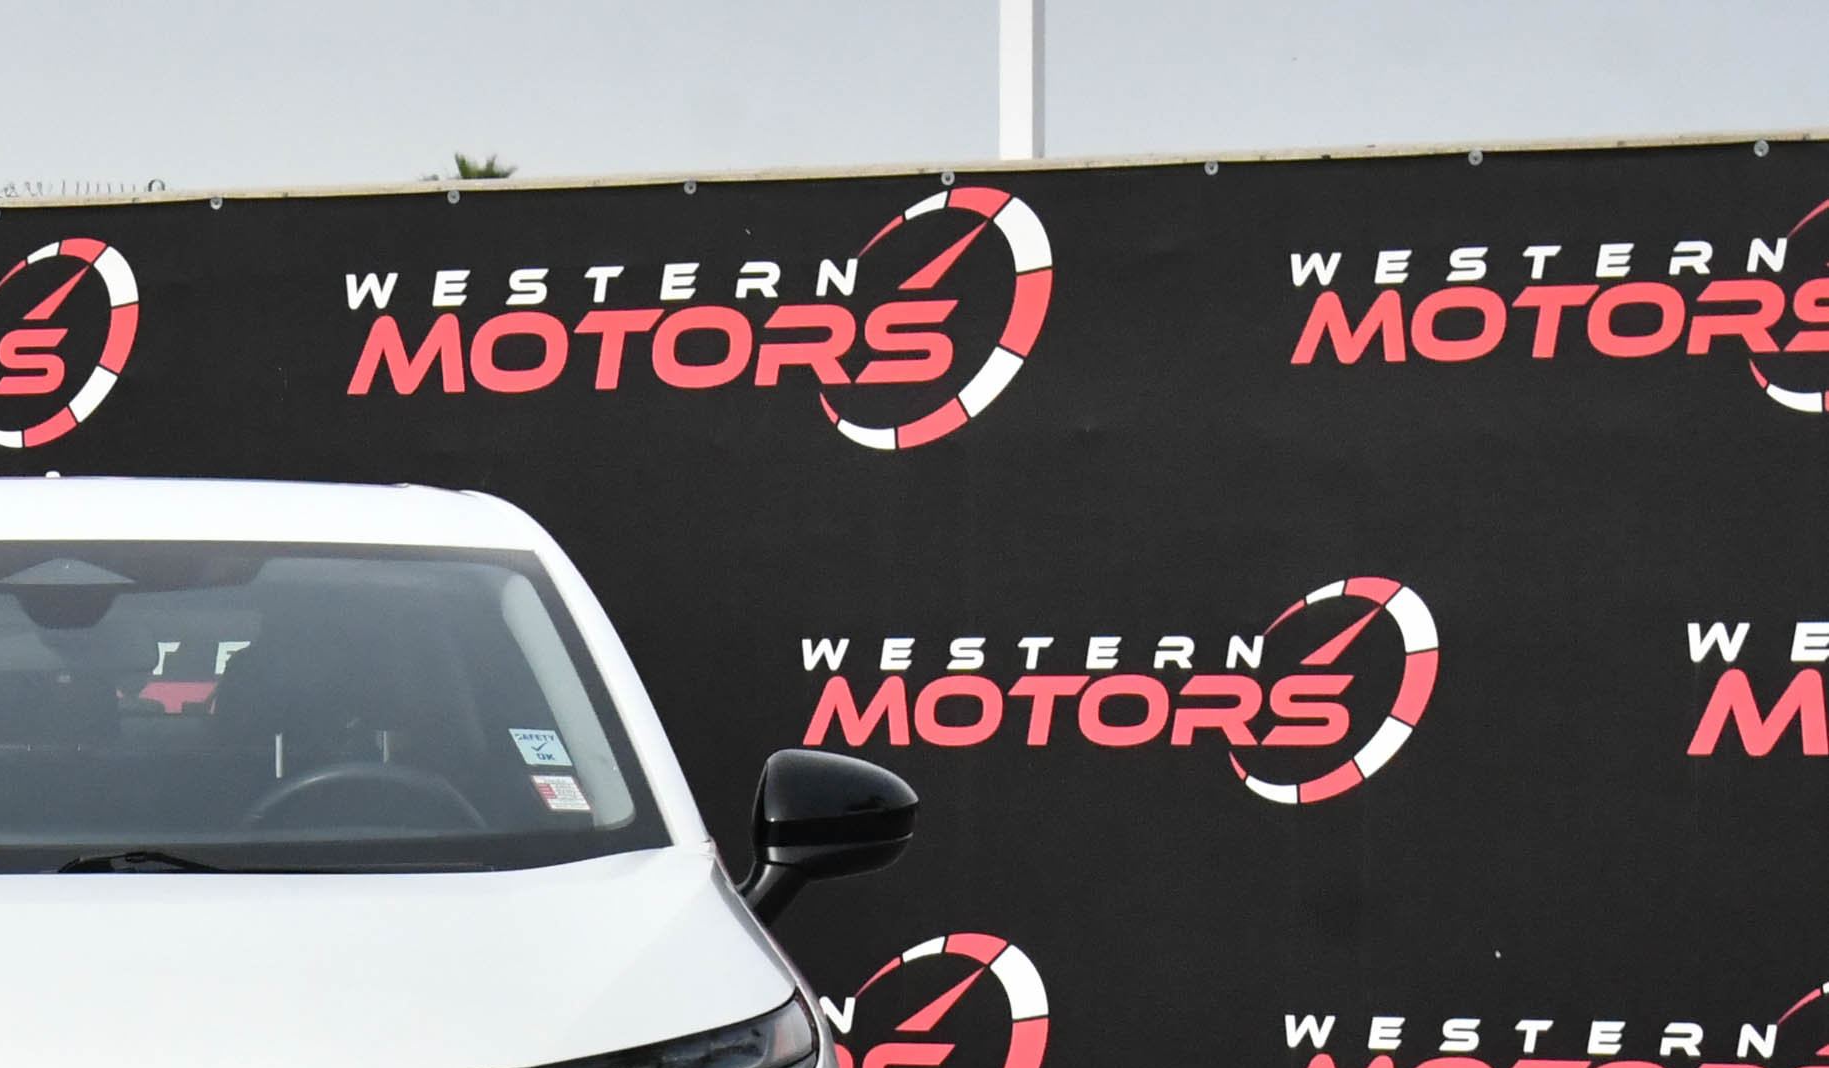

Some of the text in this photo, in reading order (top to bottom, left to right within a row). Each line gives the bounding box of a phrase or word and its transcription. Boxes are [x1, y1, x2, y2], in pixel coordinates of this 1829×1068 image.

[345, 257, 859, 311] WESTERN
[1290, 237, 1788, 288] WESTERN
[346, 299, 960, 396] MOTORS
[801, 634, 1265, 672] WESTERN
[802, 673, 1355, 748] MOTORS
[1284, 1014, 1778, 1059] WESTERN
